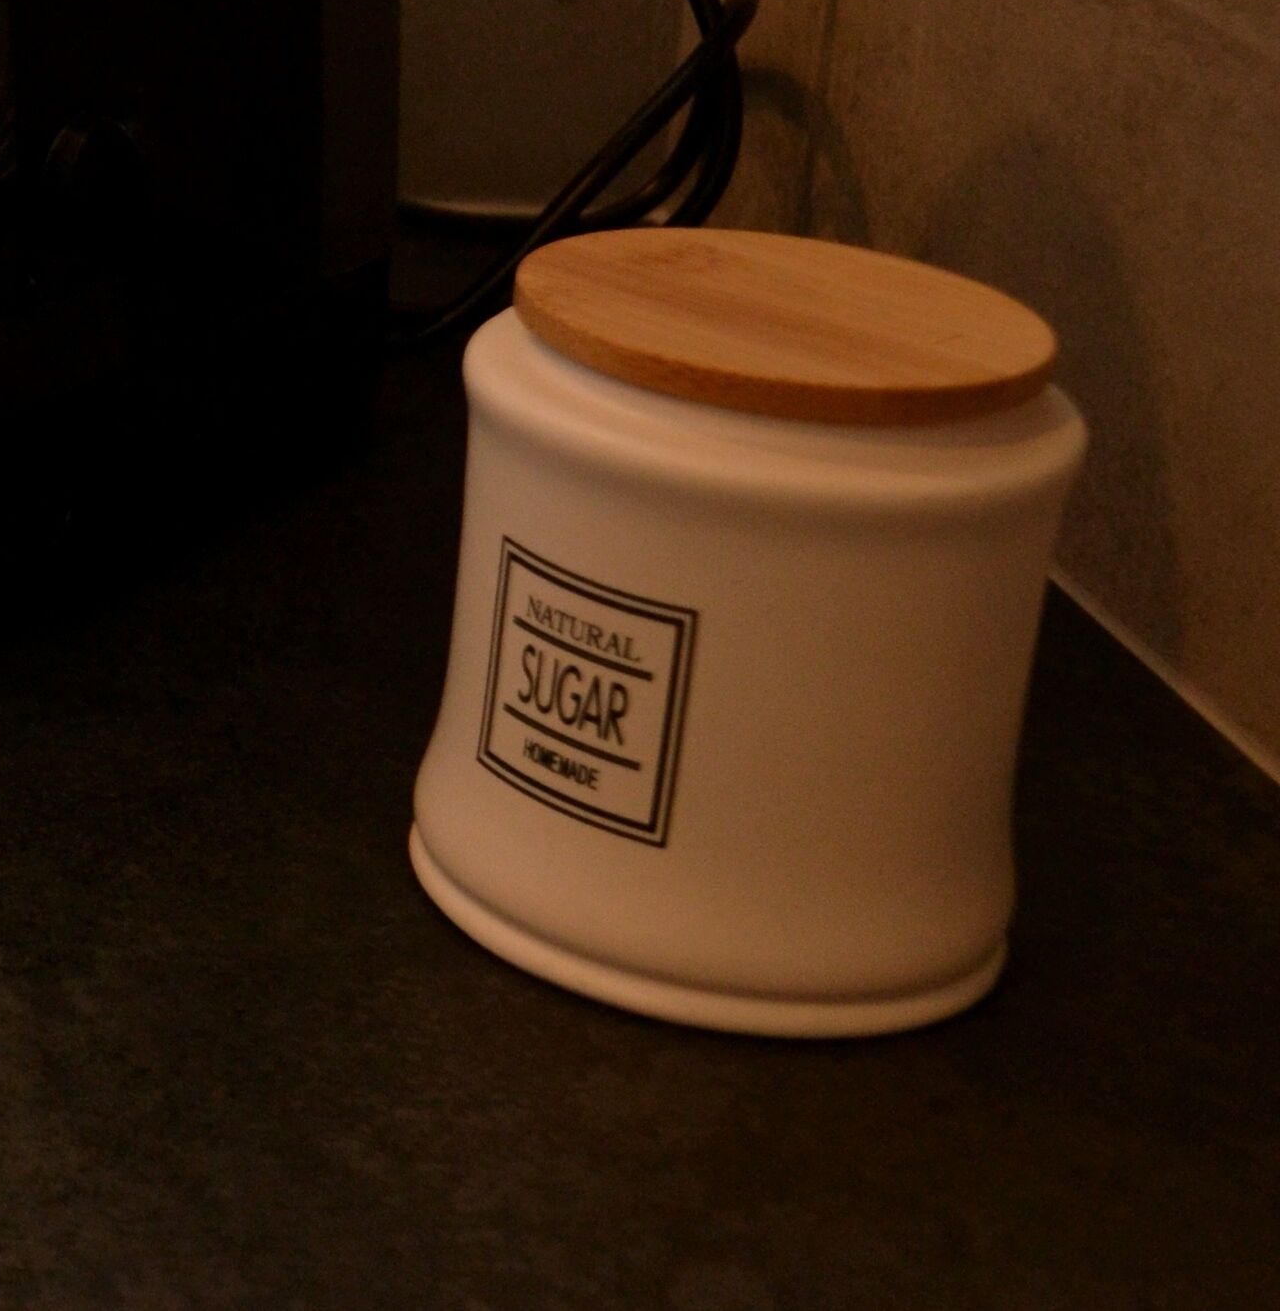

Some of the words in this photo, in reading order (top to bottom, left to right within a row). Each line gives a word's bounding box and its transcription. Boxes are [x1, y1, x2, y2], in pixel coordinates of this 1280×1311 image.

[525, 595, 641, 663] NATURAL
[517, 643, 629, 746] SUGAR
[523, 737, 601, 791] HOMEMADE
